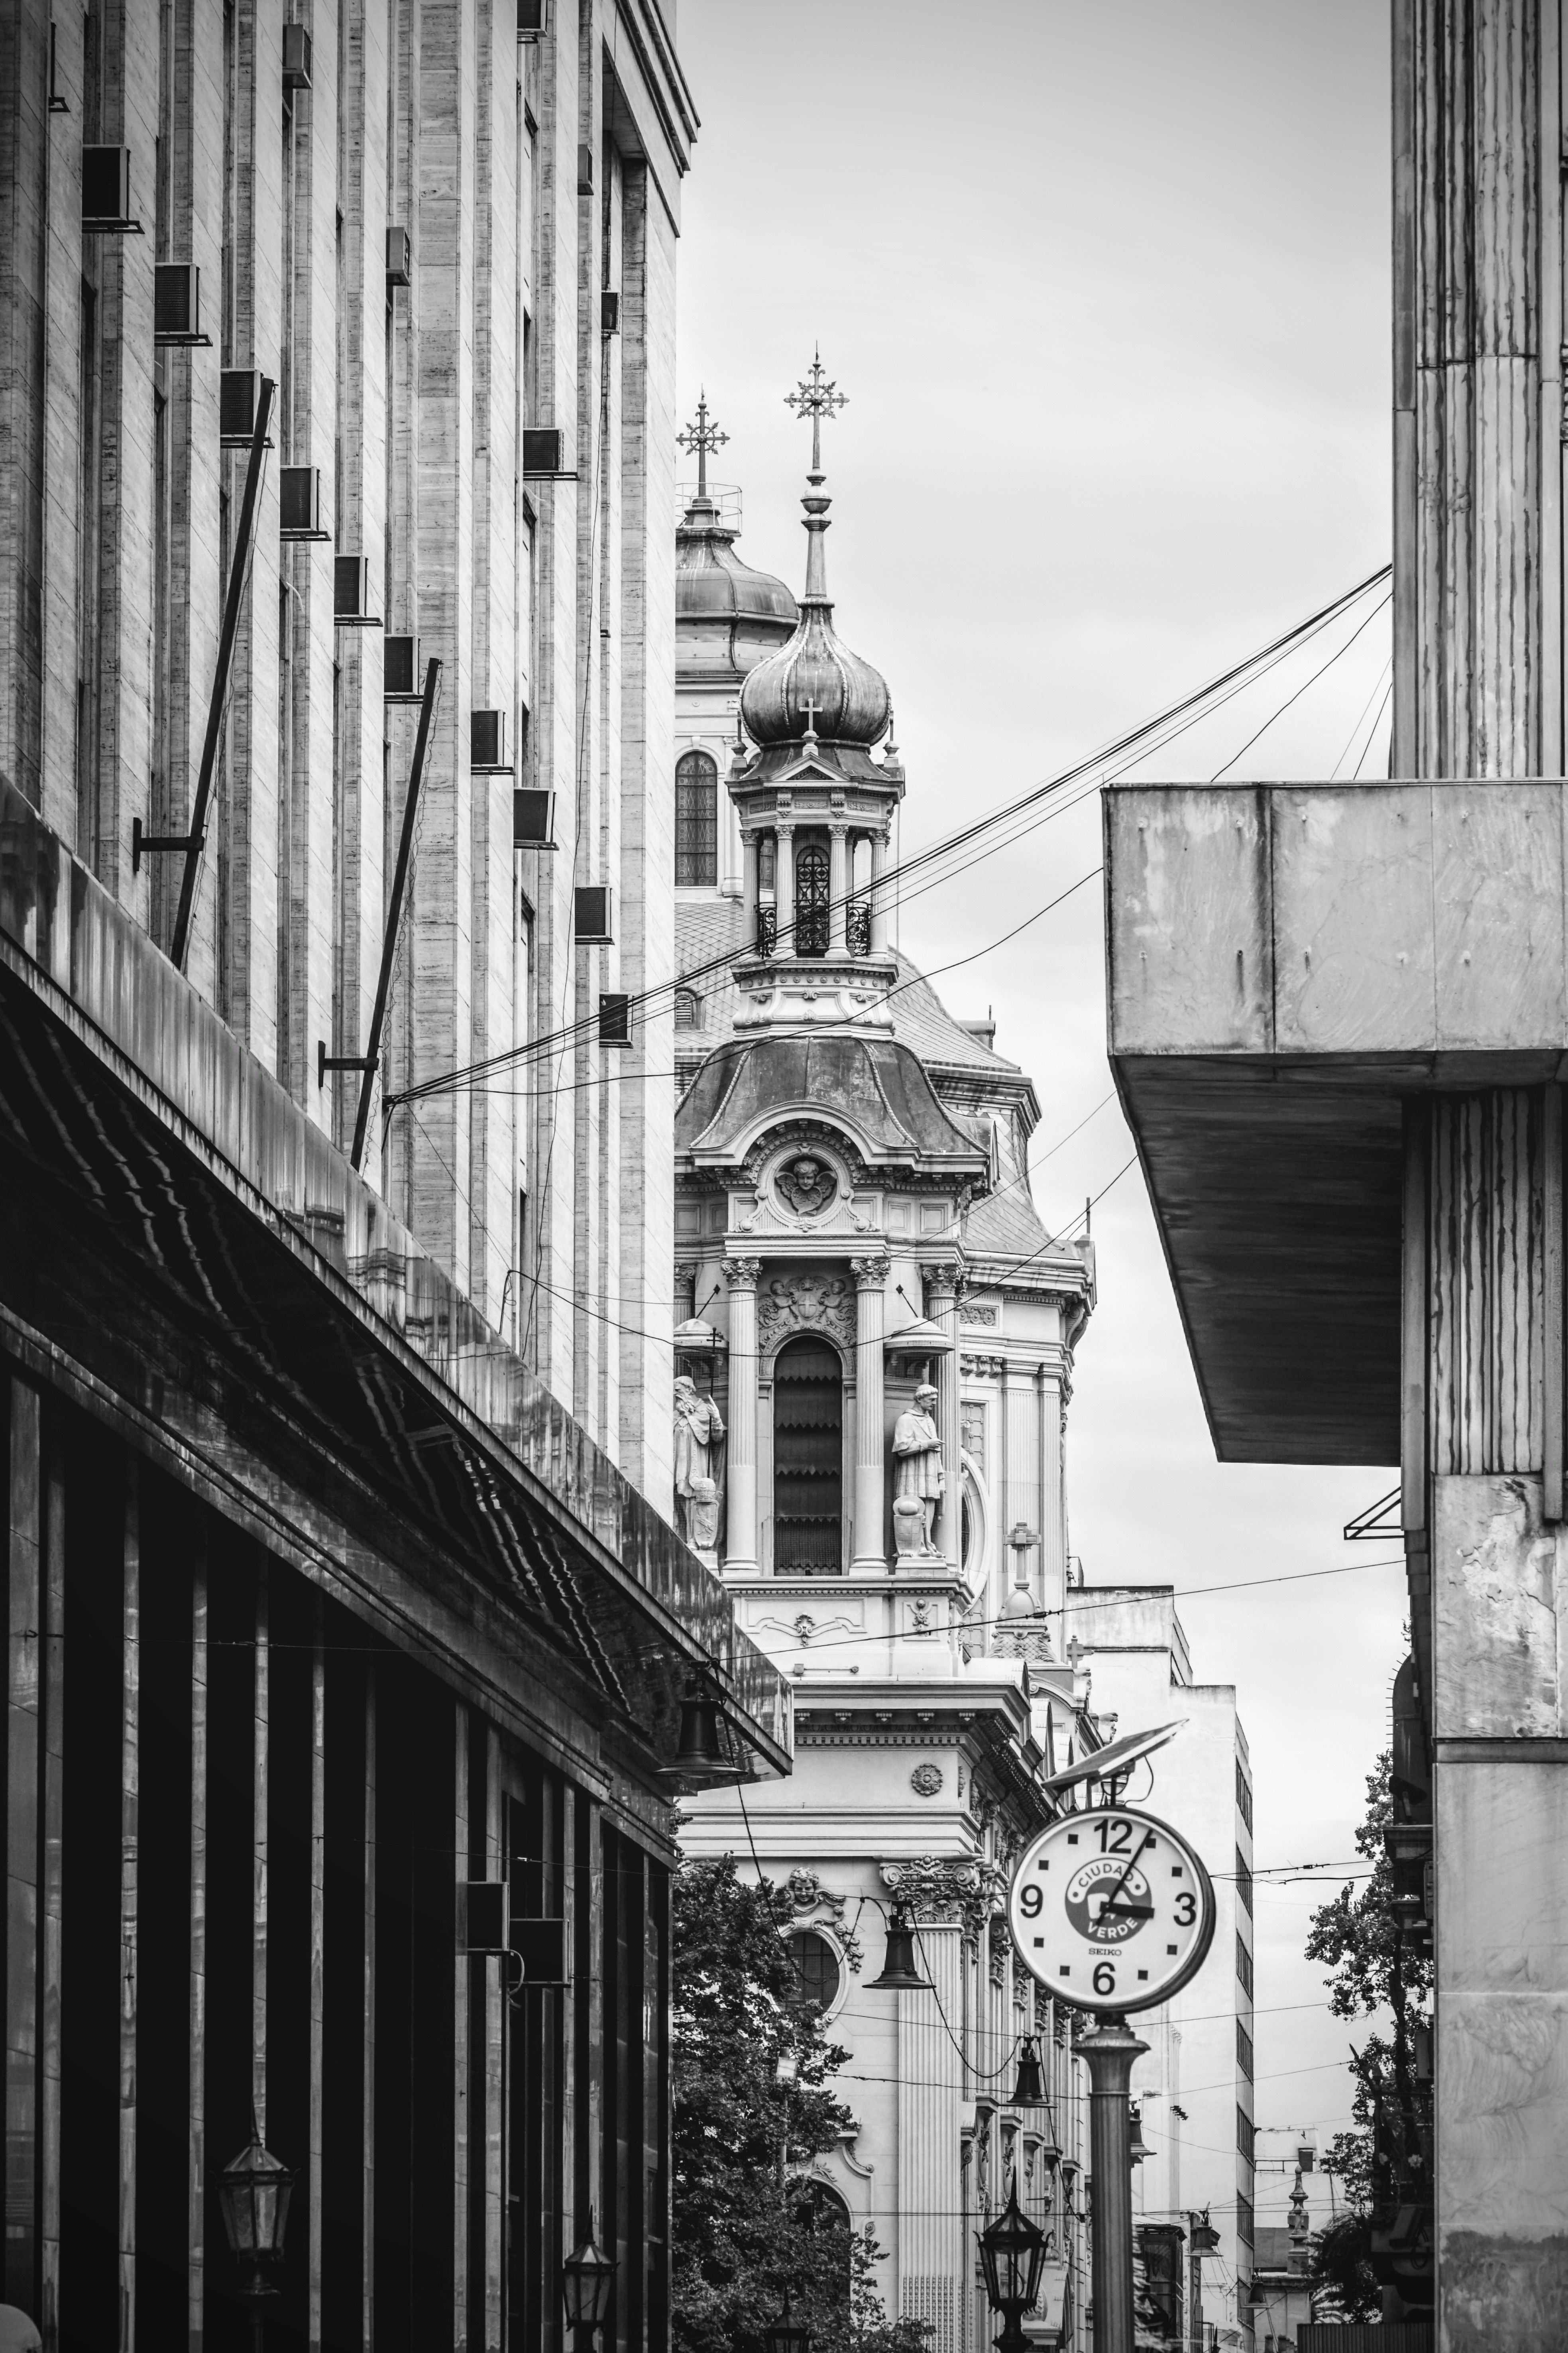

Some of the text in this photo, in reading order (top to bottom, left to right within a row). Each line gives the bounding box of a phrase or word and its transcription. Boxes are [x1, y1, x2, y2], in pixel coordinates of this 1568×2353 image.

[1094, 1819, 1132, 1854] 12
[1020, 1884, 1043, 1918] 9
[1173, 1893, 1196, 1926] 3
[1088, 1917, 1138, 1938] VERDE
[1089, 1948, 1122, 1956] SEIKO
[1093, 1962, 1115, 1995] 6
